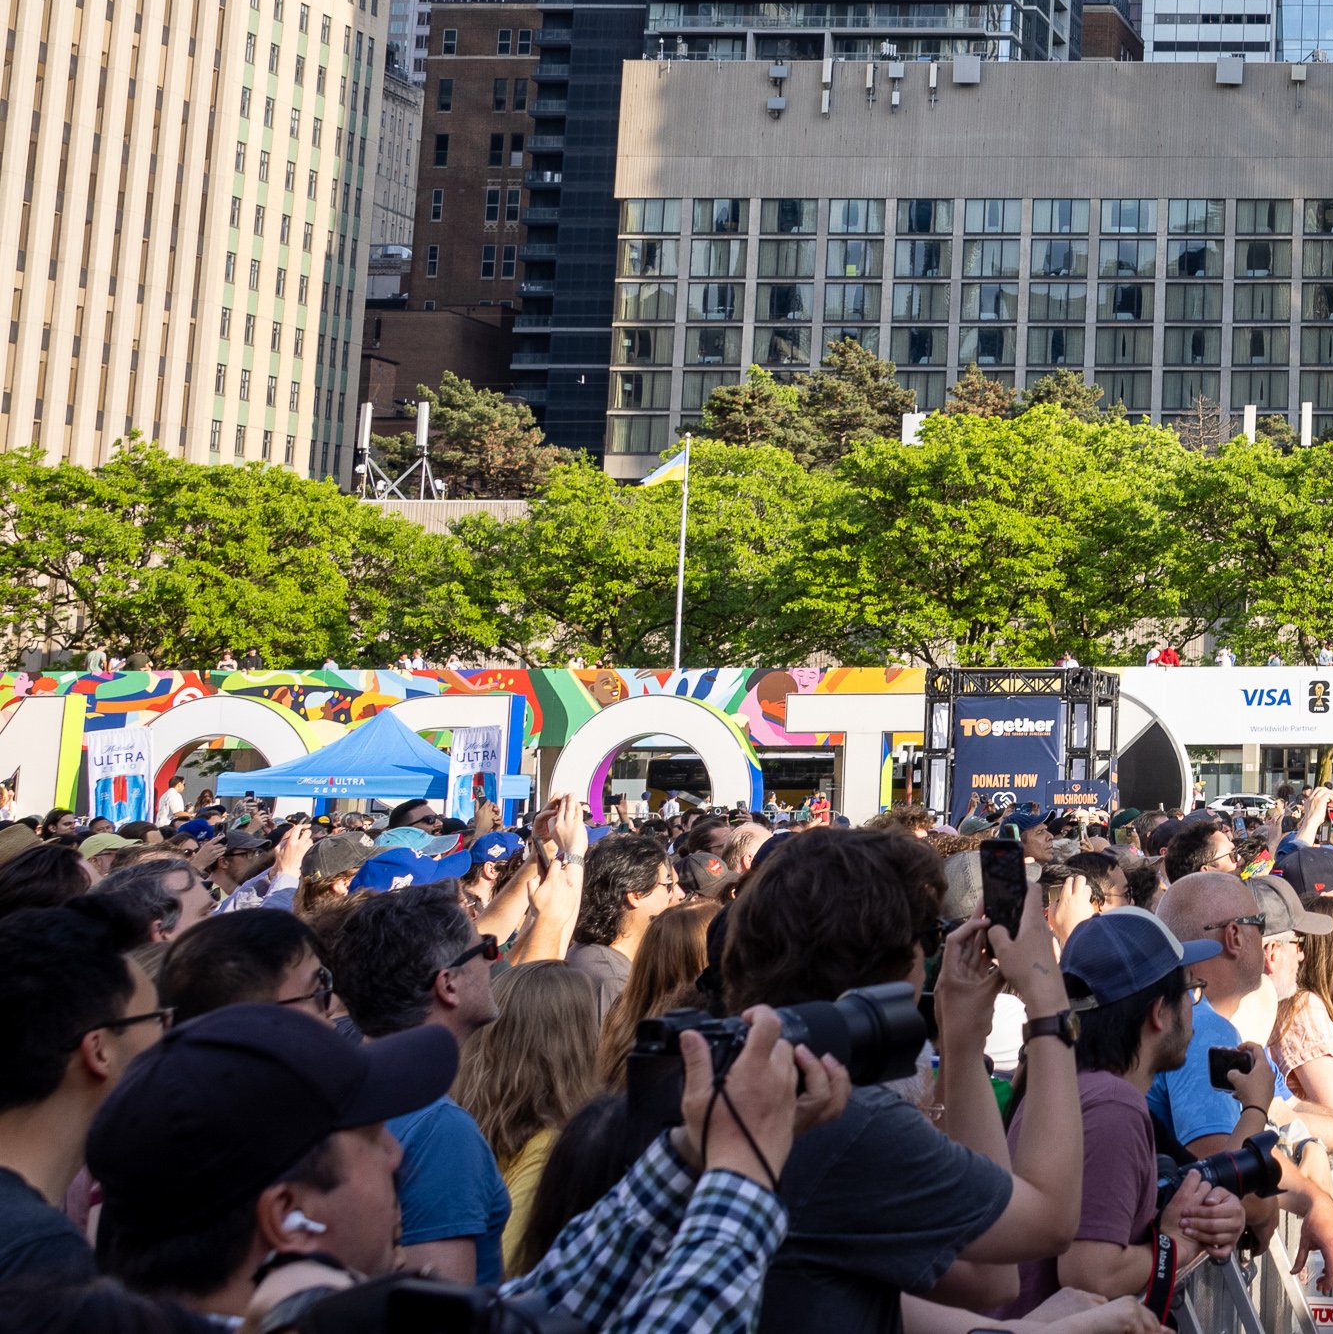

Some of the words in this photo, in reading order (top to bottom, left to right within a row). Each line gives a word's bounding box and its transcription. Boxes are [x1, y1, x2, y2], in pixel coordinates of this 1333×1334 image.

[1240, 688, 1292, 706] VISA
[1250, 725, 1289, 733] Worldwide
[1290, 725, 1317, 733] Partner
[94, 751, 145, 766] ULTRA
[456, 750, 497, 763] ULTRA
[335, 778, 365, 786] ULTRA
[972, 774, 1010, 788] DONATE
[1014, 773, 1038, 788] NOW
[1054, 793, 1098, 805] WASHROOMS
[1158, 1251, 1167, 1271] Mark
